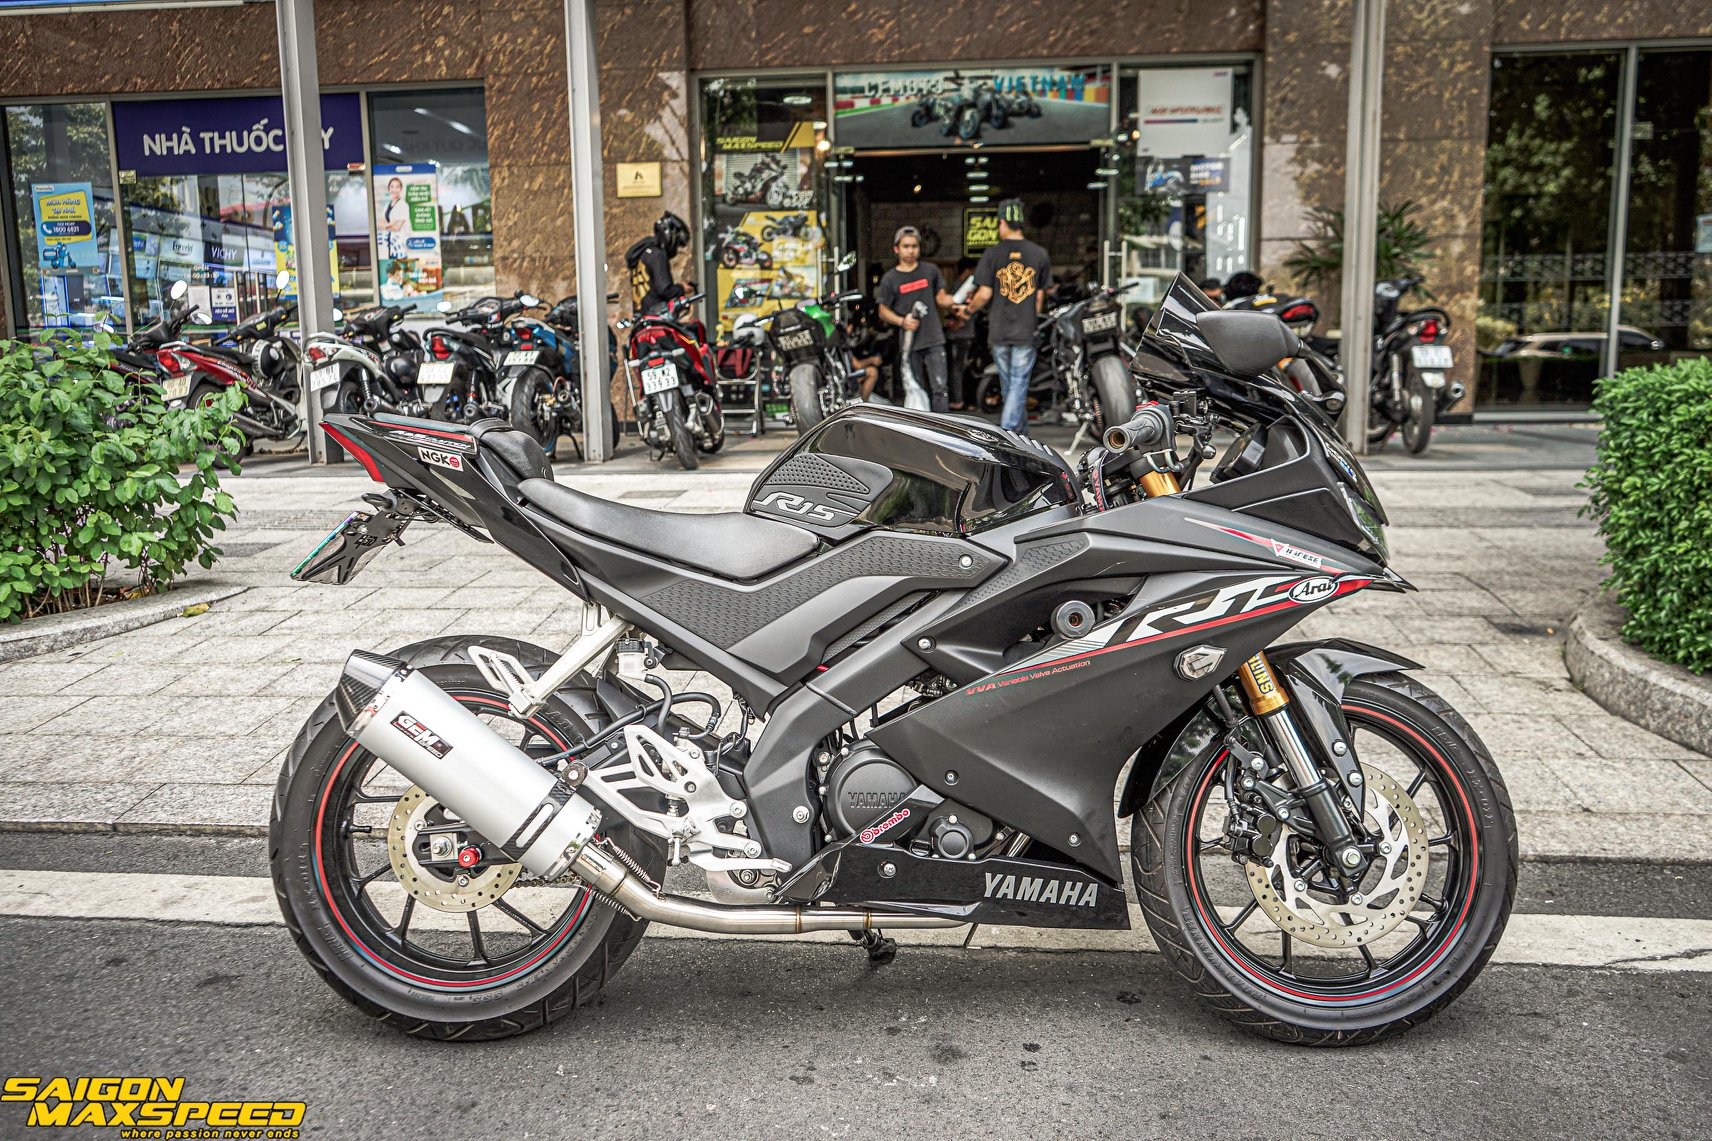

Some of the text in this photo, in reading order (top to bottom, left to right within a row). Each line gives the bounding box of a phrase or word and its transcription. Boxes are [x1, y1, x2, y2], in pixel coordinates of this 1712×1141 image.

[992, 72, 1086, 93] VIETNAM
[143, 125, 196, 156] NHÀ
[200, 117, 284, 154] THUỐC
[211, 246, 238, 260] VICHY
[420, 449, 451, 466] NGK
[966, 660, 1091, 695] VVA Variable Valve Actuation
[397, 715, 440, 746] GEM
[869, 808, 911, 838] brembo
[984, 872, 1098, 907] YAMAHA
